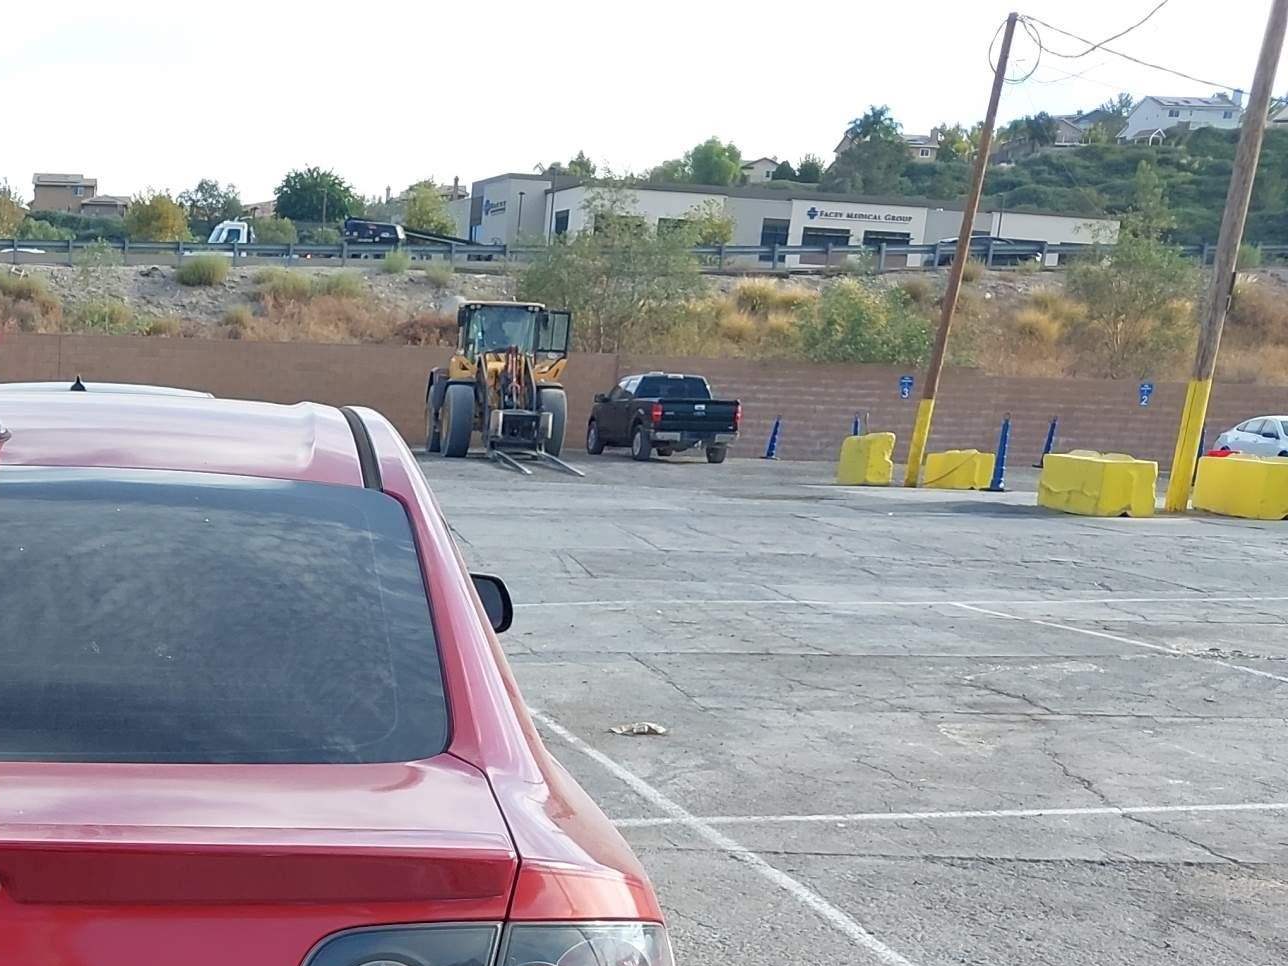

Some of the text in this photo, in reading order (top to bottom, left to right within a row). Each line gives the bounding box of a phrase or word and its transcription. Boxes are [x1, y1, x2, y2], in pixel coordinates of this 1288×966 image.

[846, 212, 881, 220] MEDICAL
[884, 213, 913, 222] GROUP
[902, 387, 909, 398] 3
[1141, 395, 1148, 405] 2
